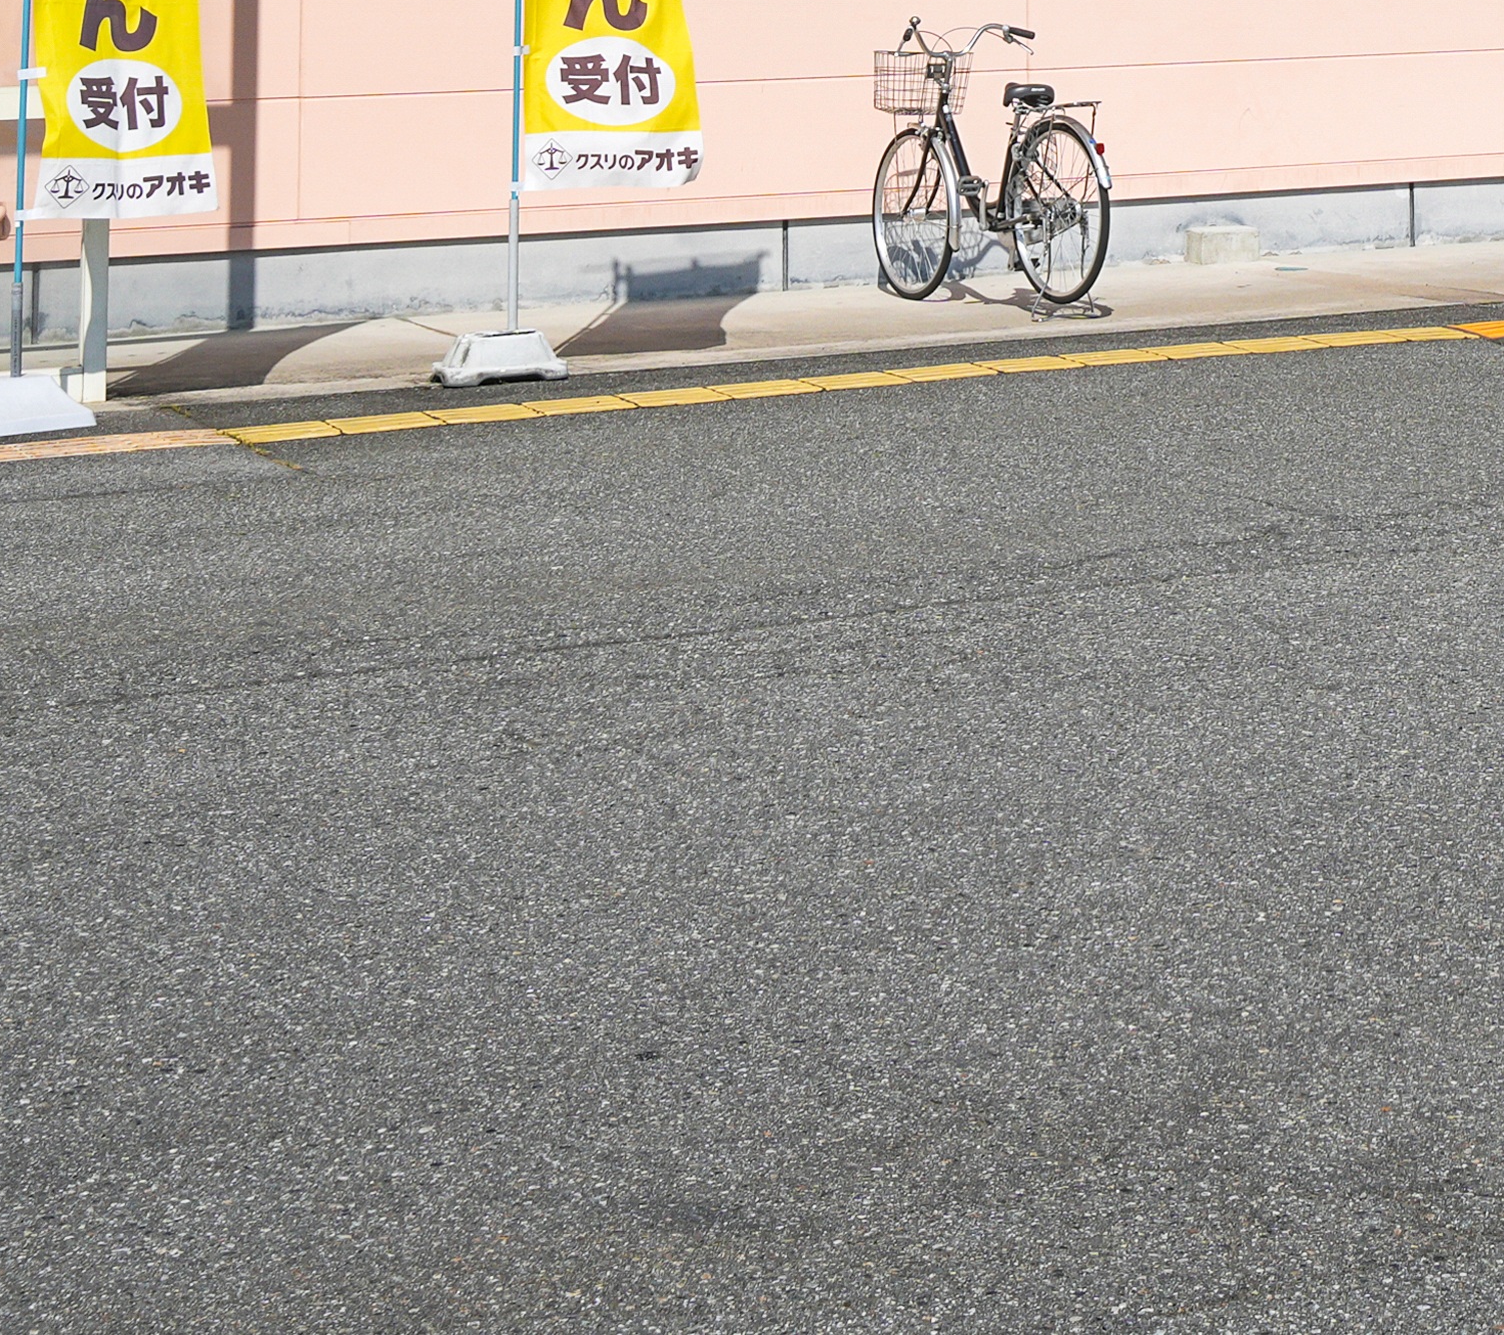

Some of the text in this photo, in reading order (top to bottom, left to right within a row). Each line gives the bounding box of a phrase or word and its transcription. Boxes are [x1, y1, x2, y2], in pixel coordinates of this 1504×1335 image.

[559, 54, 662, 107] 受付
[79, 75, 170, 131] 受付
[576, 147, 699, 172] クスリのアオキ
[92, 170, 212, 202] クスリのアオキ
